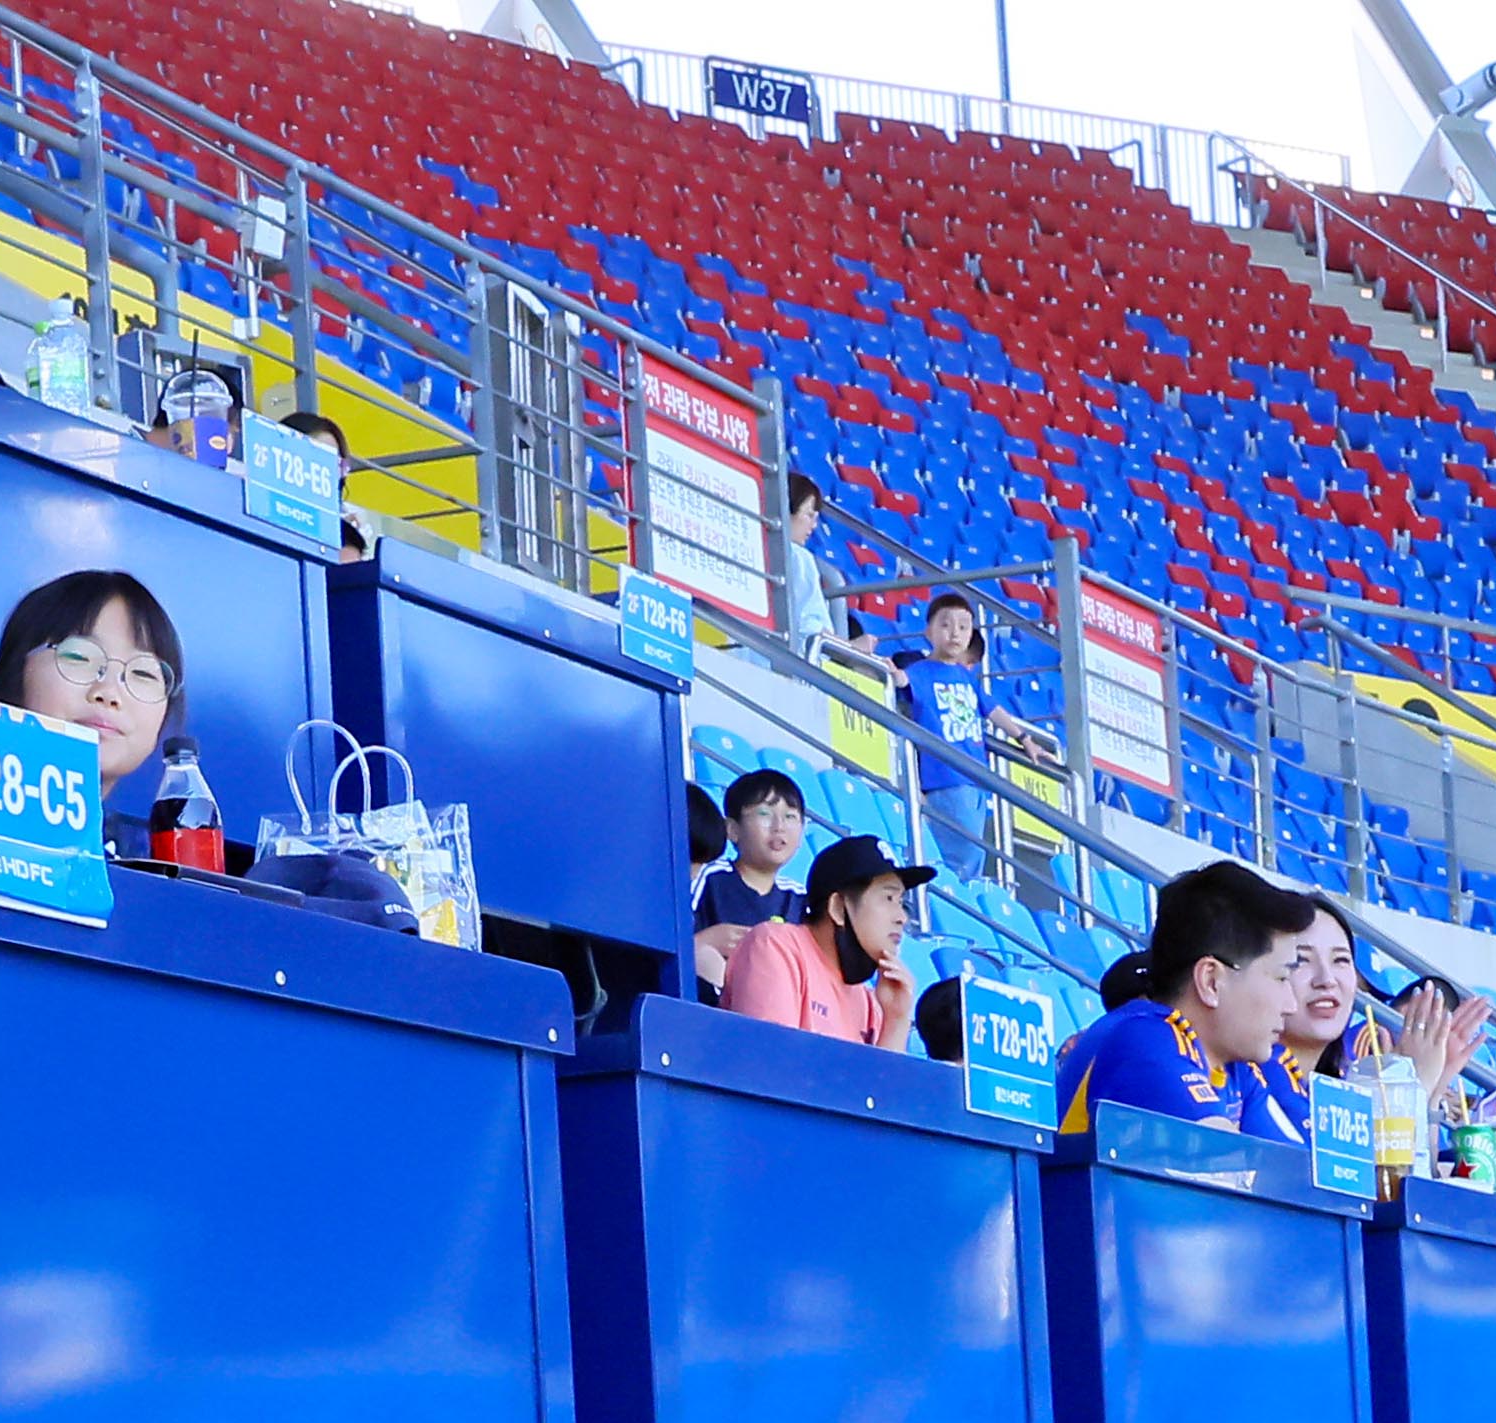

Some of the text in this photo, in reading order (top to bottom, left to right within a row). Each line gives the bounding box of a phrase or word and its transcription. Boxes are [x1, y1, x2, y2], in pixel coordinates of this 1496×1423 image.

[732, 74, 791, 114] W37
[662, 382, 750, 454] 관람 당부 사항
[272, 446, 331, 497] T28-E6
[641, 595, 686, 638] T28-F6
[3, 856, 28, 879] HD
[29, 864, 53, 886] FC
[972, 1013, 1047, 1066] 2F T28-D5
[1330, 1104, 1369, 1147] T28-E5
